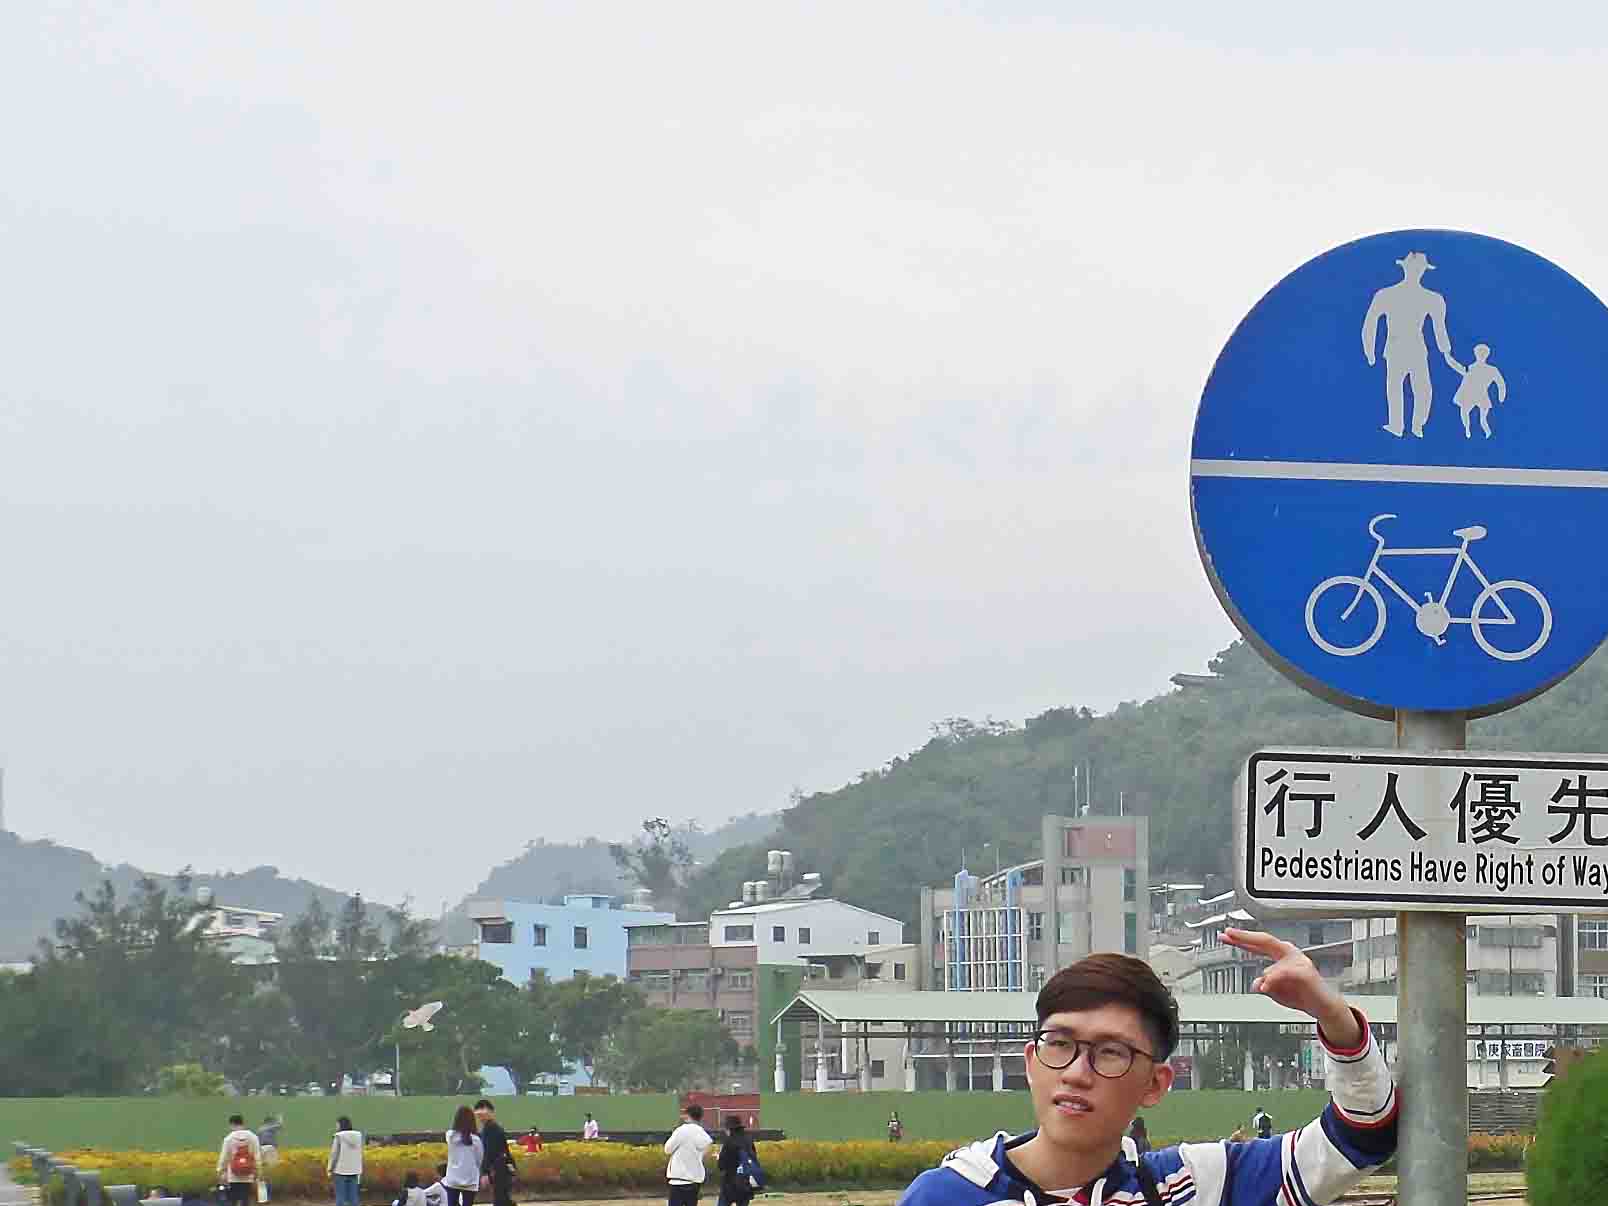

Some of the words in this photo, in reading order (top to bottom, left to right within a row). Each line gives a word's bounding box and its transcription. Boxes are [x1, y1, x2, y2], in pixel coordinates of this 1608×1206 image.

[1261, 848, 1402, 881] Pedestrians
[1410, 852, 1467, 884] Have
[1475, 853, 1534, 892] Right
[1542, 855, 1565, 885] of
